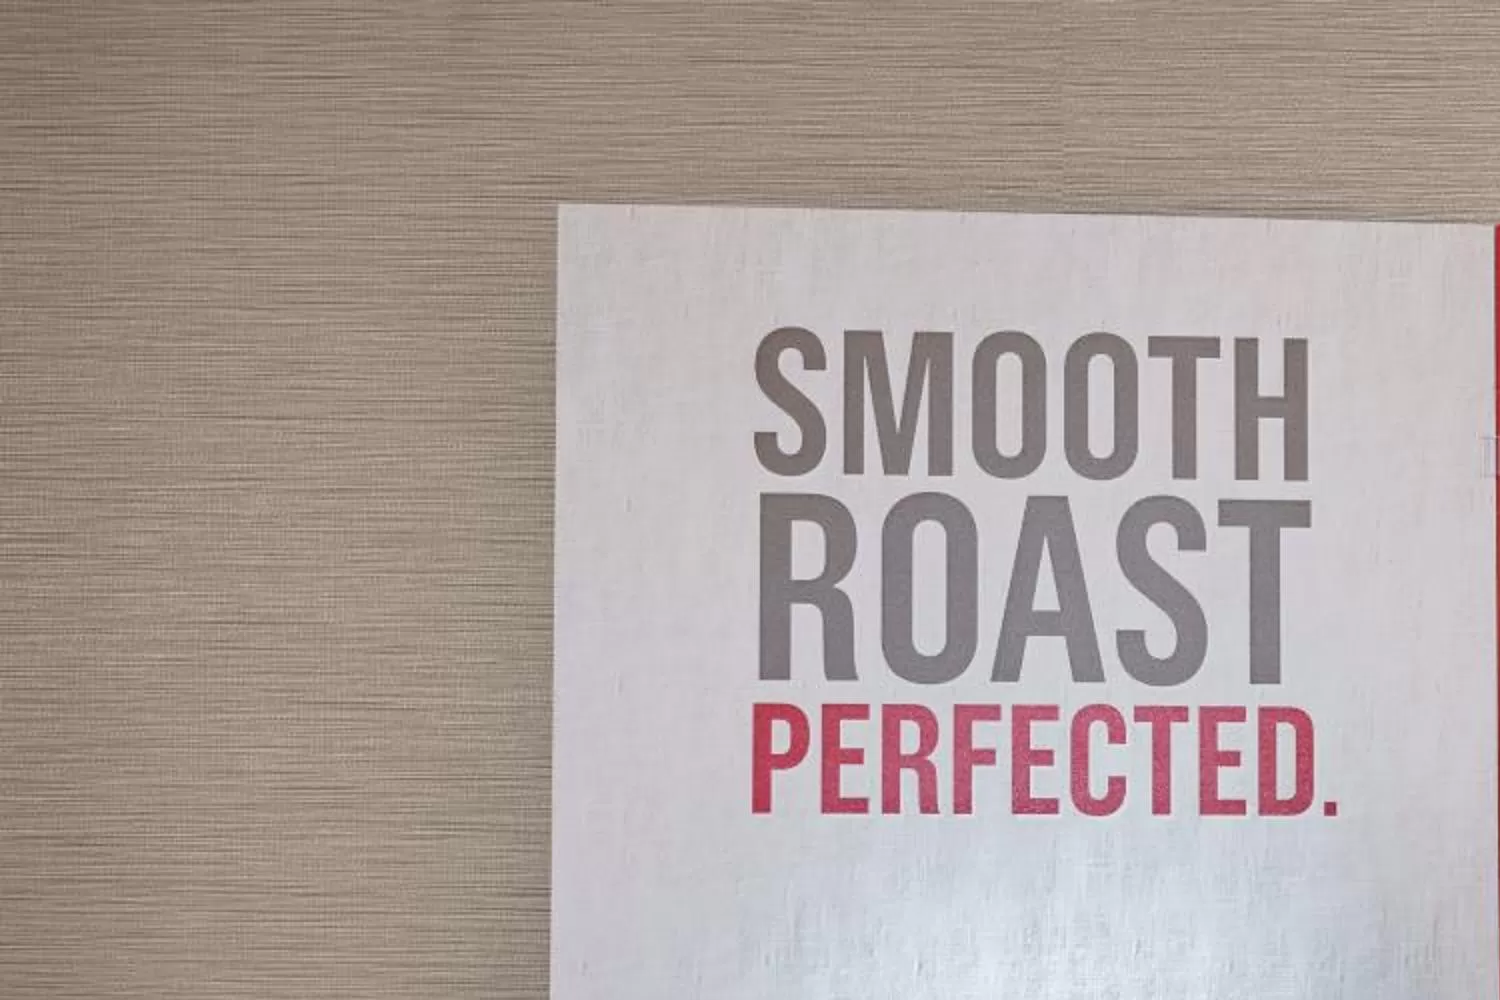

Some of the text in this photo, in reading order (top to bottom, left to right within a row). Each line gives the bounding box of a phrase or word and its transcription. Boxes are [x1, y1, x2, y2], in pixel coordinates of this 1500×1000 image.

[753, 326, 1309, 482] SMOOTH
[757, 491, 1312, 687] ROAST
[751, 702, 1338, 817] PERFECTED.
